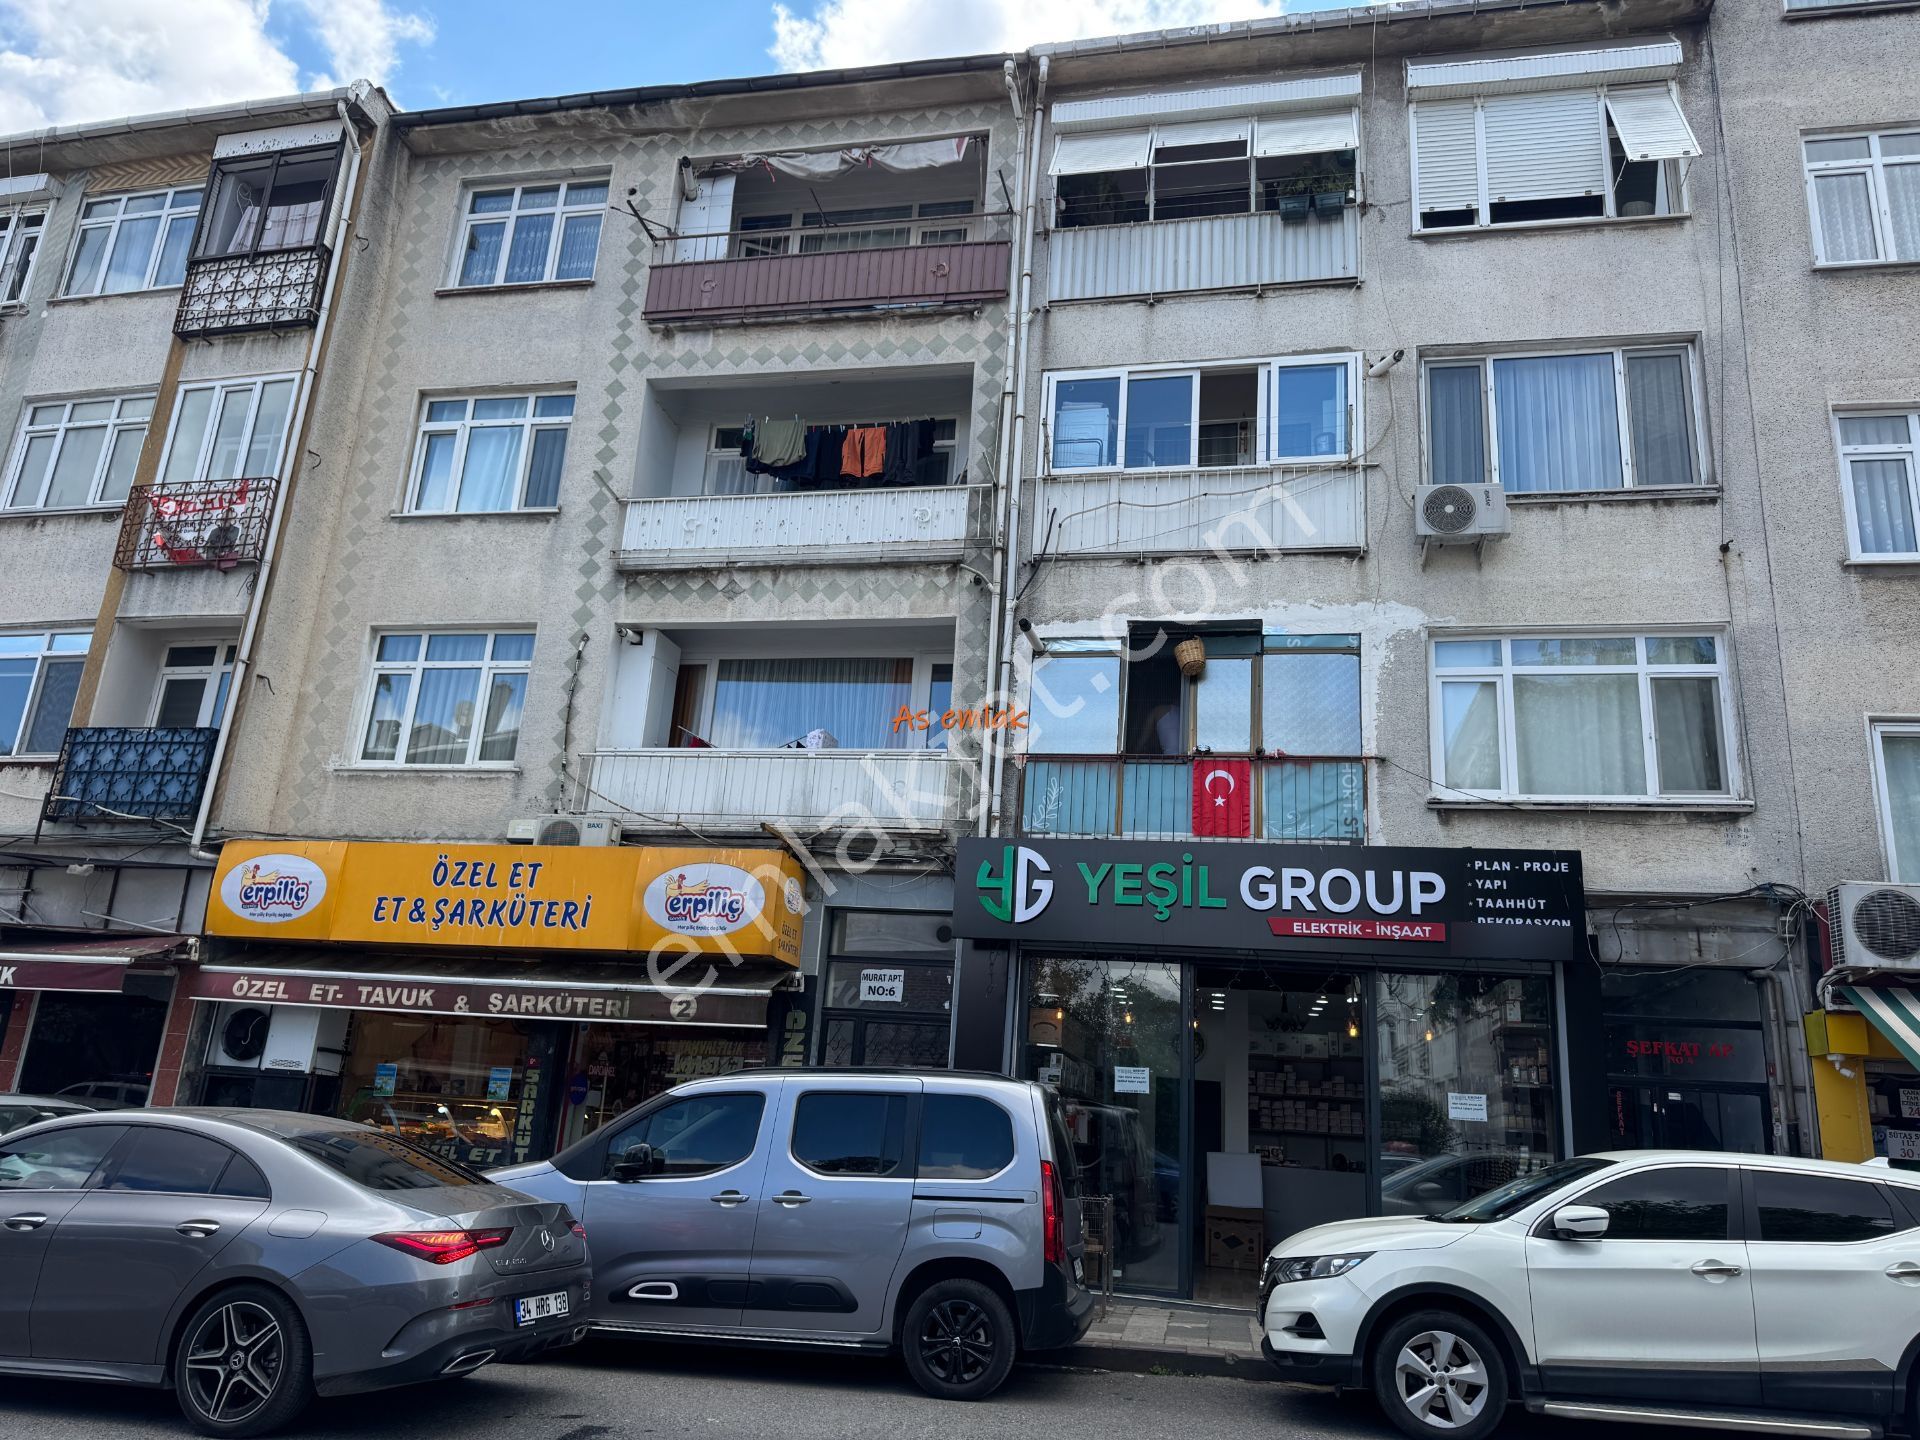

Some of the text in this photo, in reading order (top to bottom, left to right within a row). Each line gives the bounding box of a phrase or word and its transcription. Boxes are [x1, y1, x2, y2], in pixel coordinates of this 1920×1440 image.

[432, 854, 543, 889] ÖZEL ET
[1474, 860, 1511, 871] PLAN
[1523, 861, 1569, 873] PROJE
[242, 877, 307, 908] erpiliç
[1077, 853, 1446, 921] YEŞİL GROUP
[1475, 879, 1507, 890] YAPI
[668, 888, 742, 920] erpiliç
[1476, 897, 1547, 910] TAAHHÜT
[1293, 921, 1363, 935] ELEKTRİK
[1376, 922, 1432, 939] İNŞAAT
[0, 966, 18, 985] K
[862, 973, 903, 982] MURAT APT.
[232, 977, 288, 999] ÖZEL
[357, 985, 436, 1007] TAVUK
[453, 995, 470, 1013] &
[488, 992, 630, 1018] ŞARKÜTERİ
[868, 985, 896, 996] NO:6
[1626, 1040, 1701, 1057] ŞEFKAT
[468, 1148, 502, 1163] ET
[1901, 1148, 1914, 1158] 30
[521, 1292, 567, 1319] 34 HRG 138
